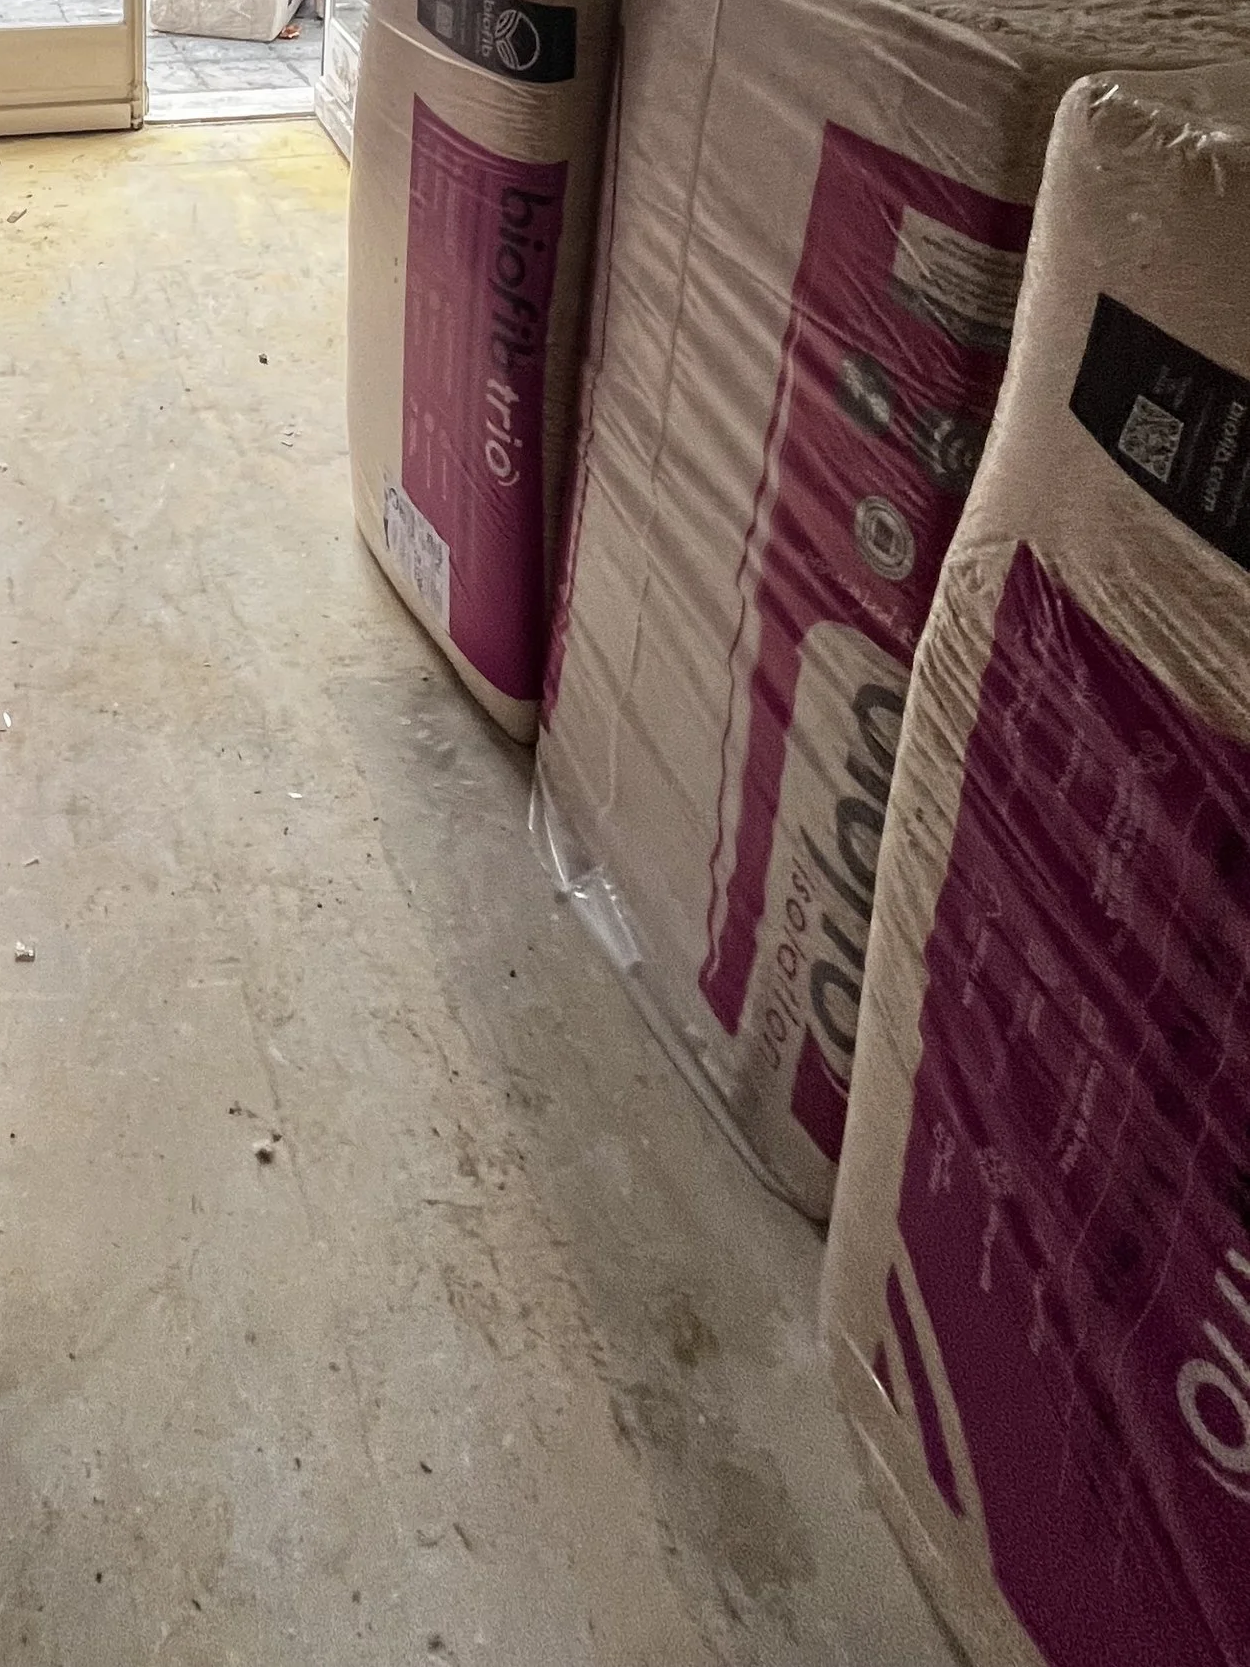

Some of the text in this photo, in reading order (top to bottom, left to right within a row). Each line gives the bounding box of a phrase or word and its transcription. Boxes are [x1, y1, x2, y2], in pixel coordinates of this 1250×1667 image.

[484, 187, 554, 487] biofib trio
[760, 859, 820, 1071] isolation
